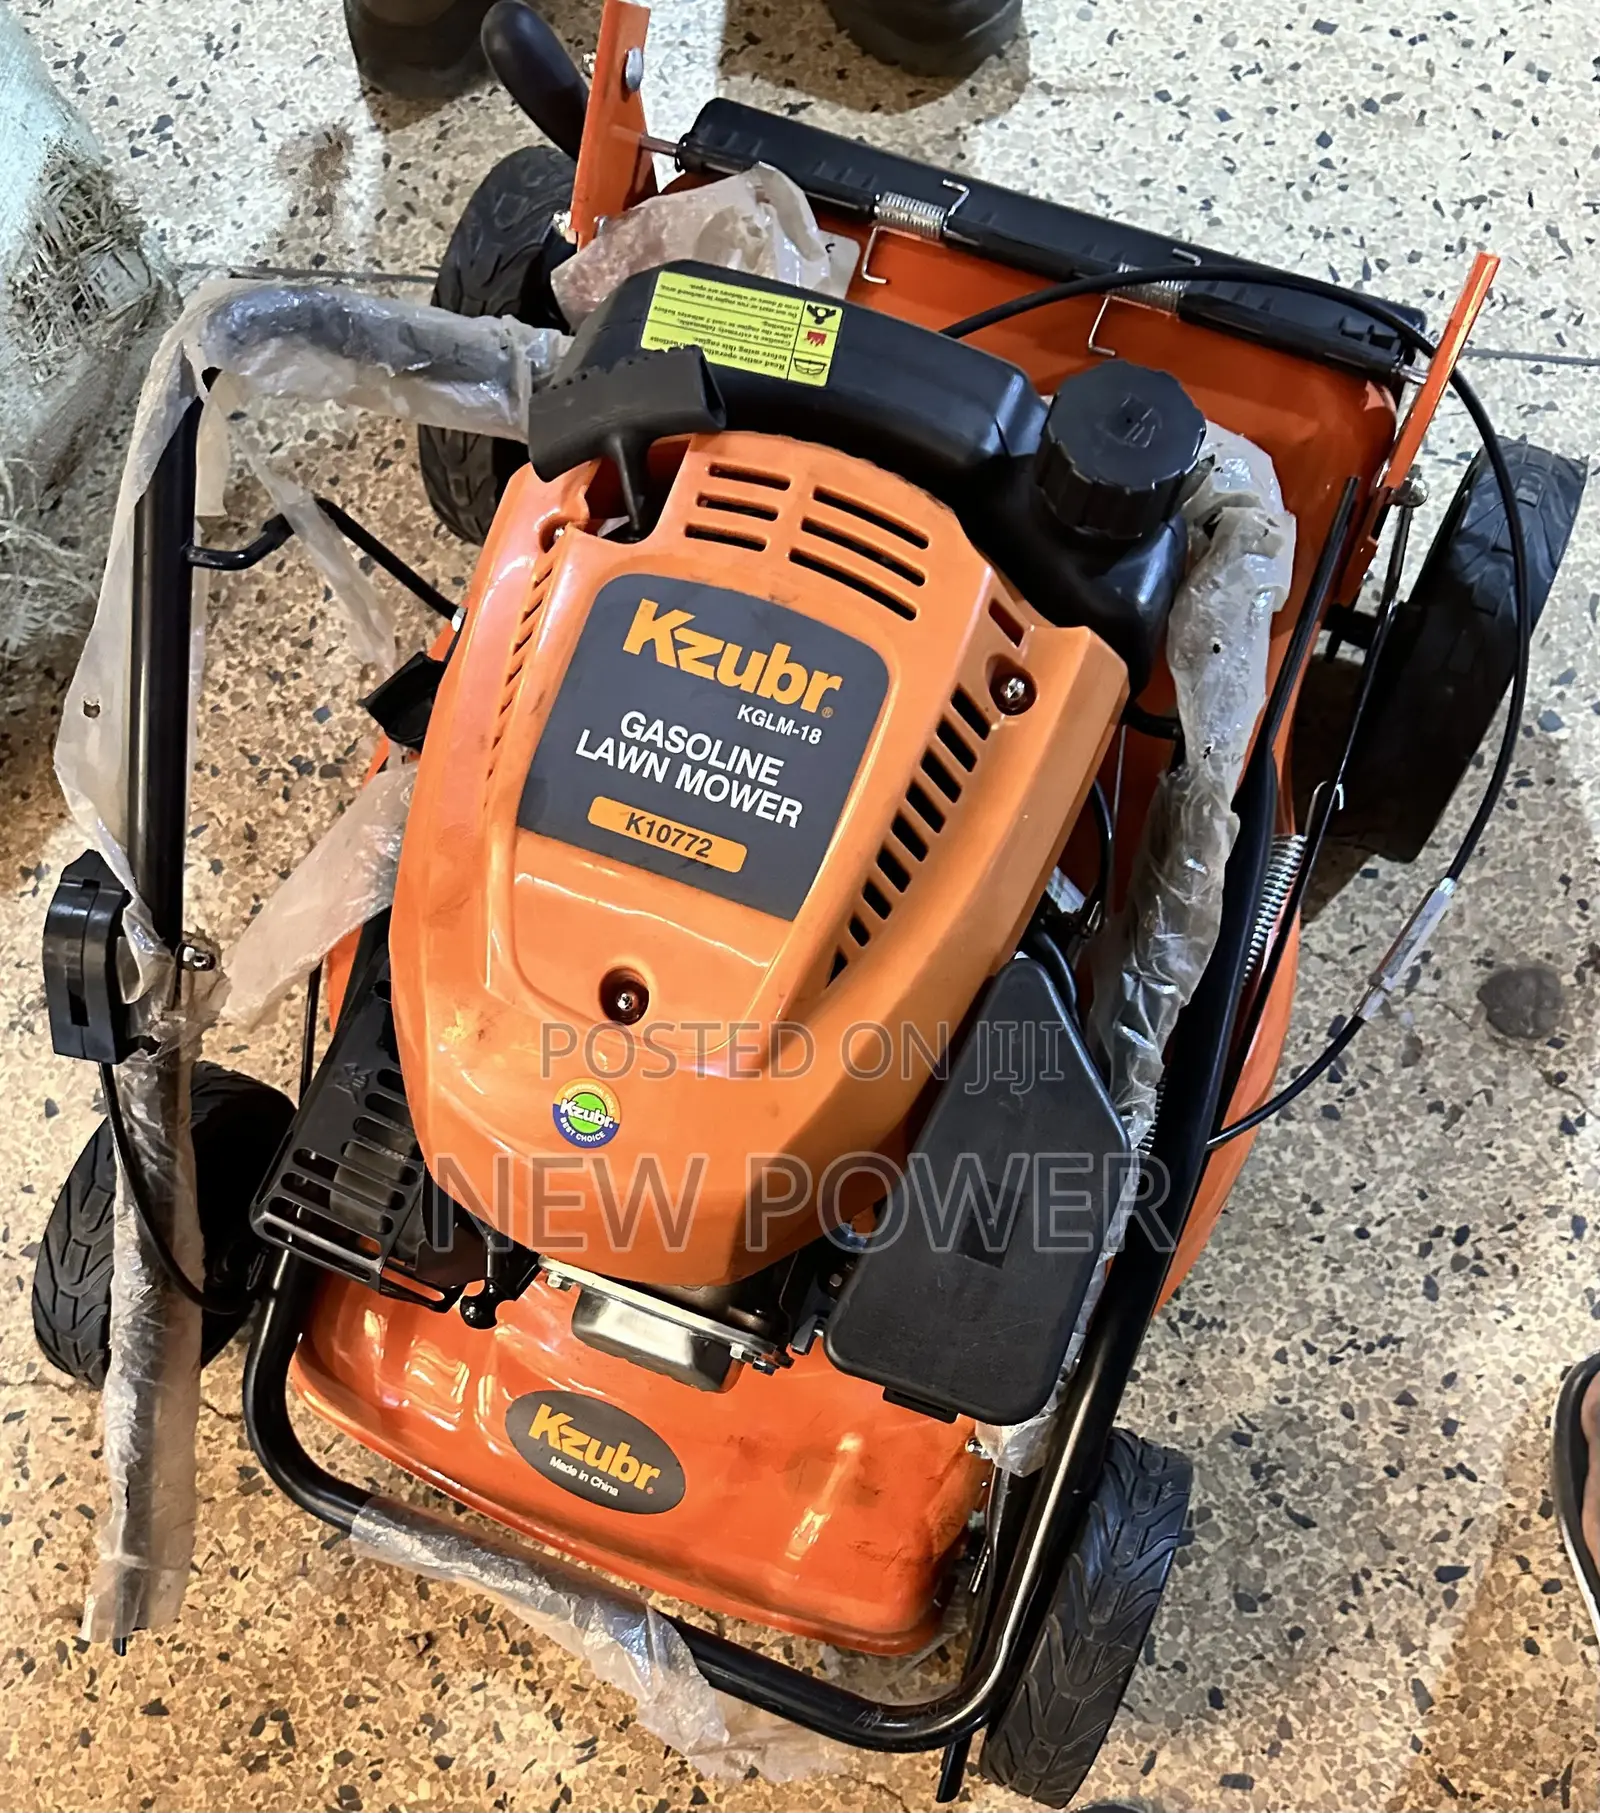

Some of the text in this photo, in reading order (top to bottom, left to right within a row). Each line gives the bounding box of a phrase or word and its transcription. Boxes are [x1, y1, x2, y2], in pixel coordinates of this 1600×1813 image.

[703, 347, 737, 359] operatin
[721, 343, 736, 351] this
[738, 345, 760, 355] using
[738, 355, 762, 364] entire
[761, 351, 787, 361] before
[764, 360, 784, 370] Read
[622, 598, 842, 714] Kzubr
[737, 704, 822, 745] KGLM-18
[620, 710, 784, 786] GASOLINE
[576, 729, 802, 828] LAWN MOWER
[625, 812, 714, 858] K10772
[560, 1098, 614, 1128] Kzubr
[560, 1117, 606, 1142] BEST CHOICE
[528, 1404, 660, 1490] Kzubr
[550, 1456, 618, 1496] Made in China
